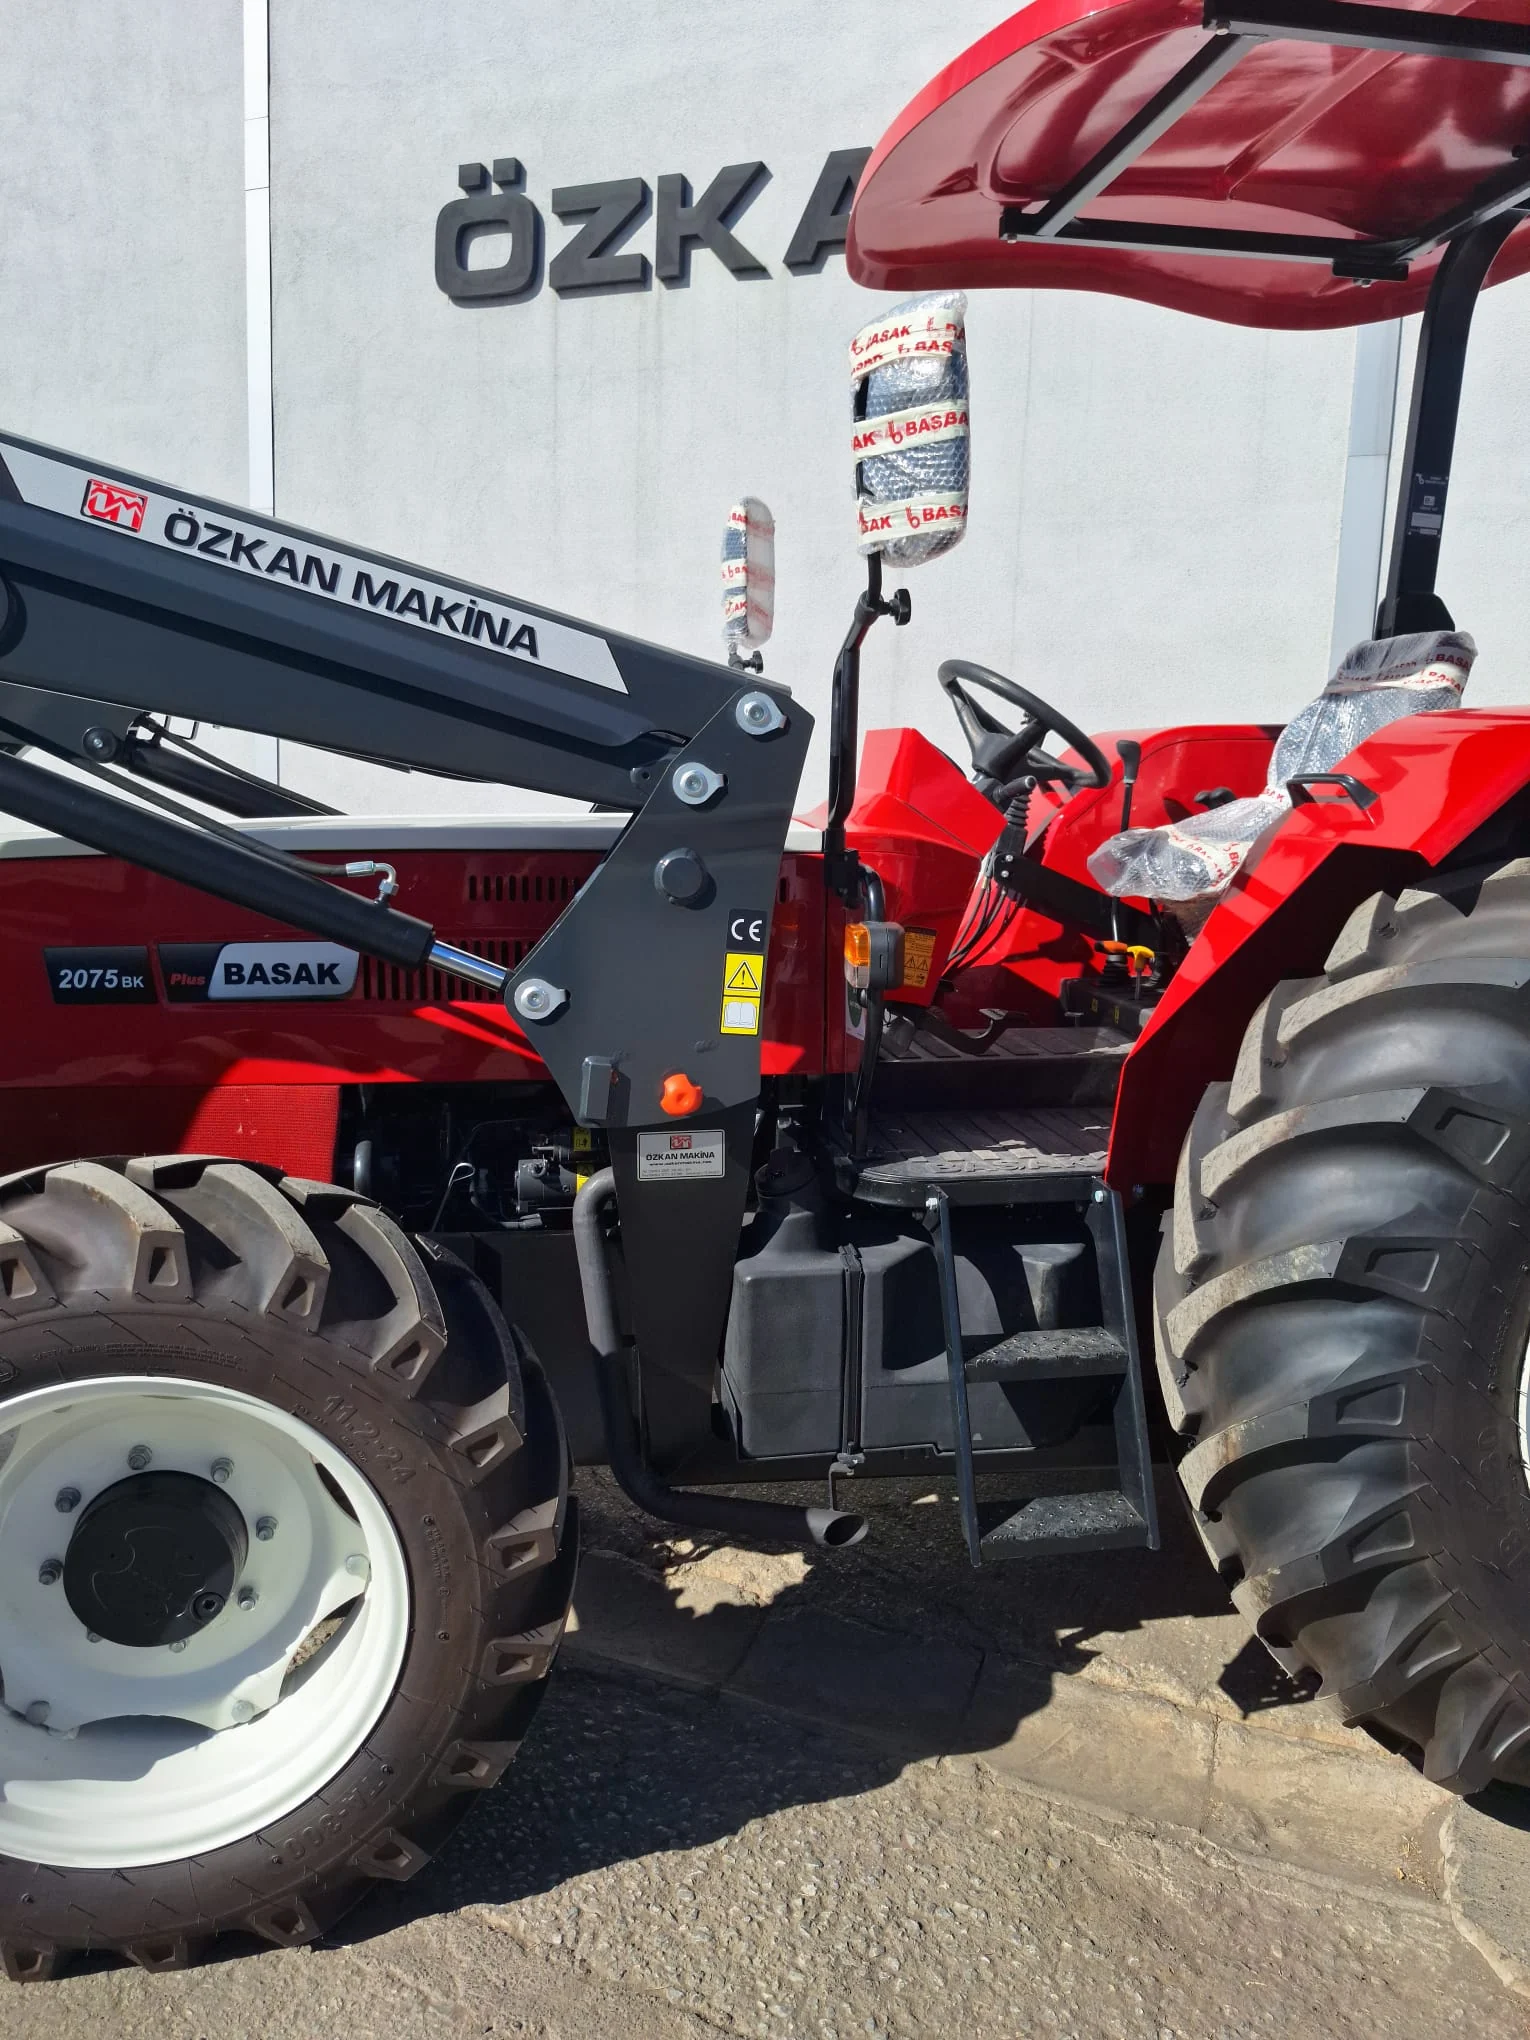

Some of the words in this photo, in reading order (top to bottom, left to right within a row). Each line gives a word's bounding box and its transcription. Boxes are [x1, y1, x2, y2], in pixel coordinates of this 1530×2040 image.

[164, 508, 341, 593] ÖZKAN
[351, 570, 540, 659] MAKİNA
[59, 969, 118, 989] 2075
[122, 977, 144, 988] BK
[170, 972, 206, 986] Plus
[223, 962, 341, 985] BASAK
